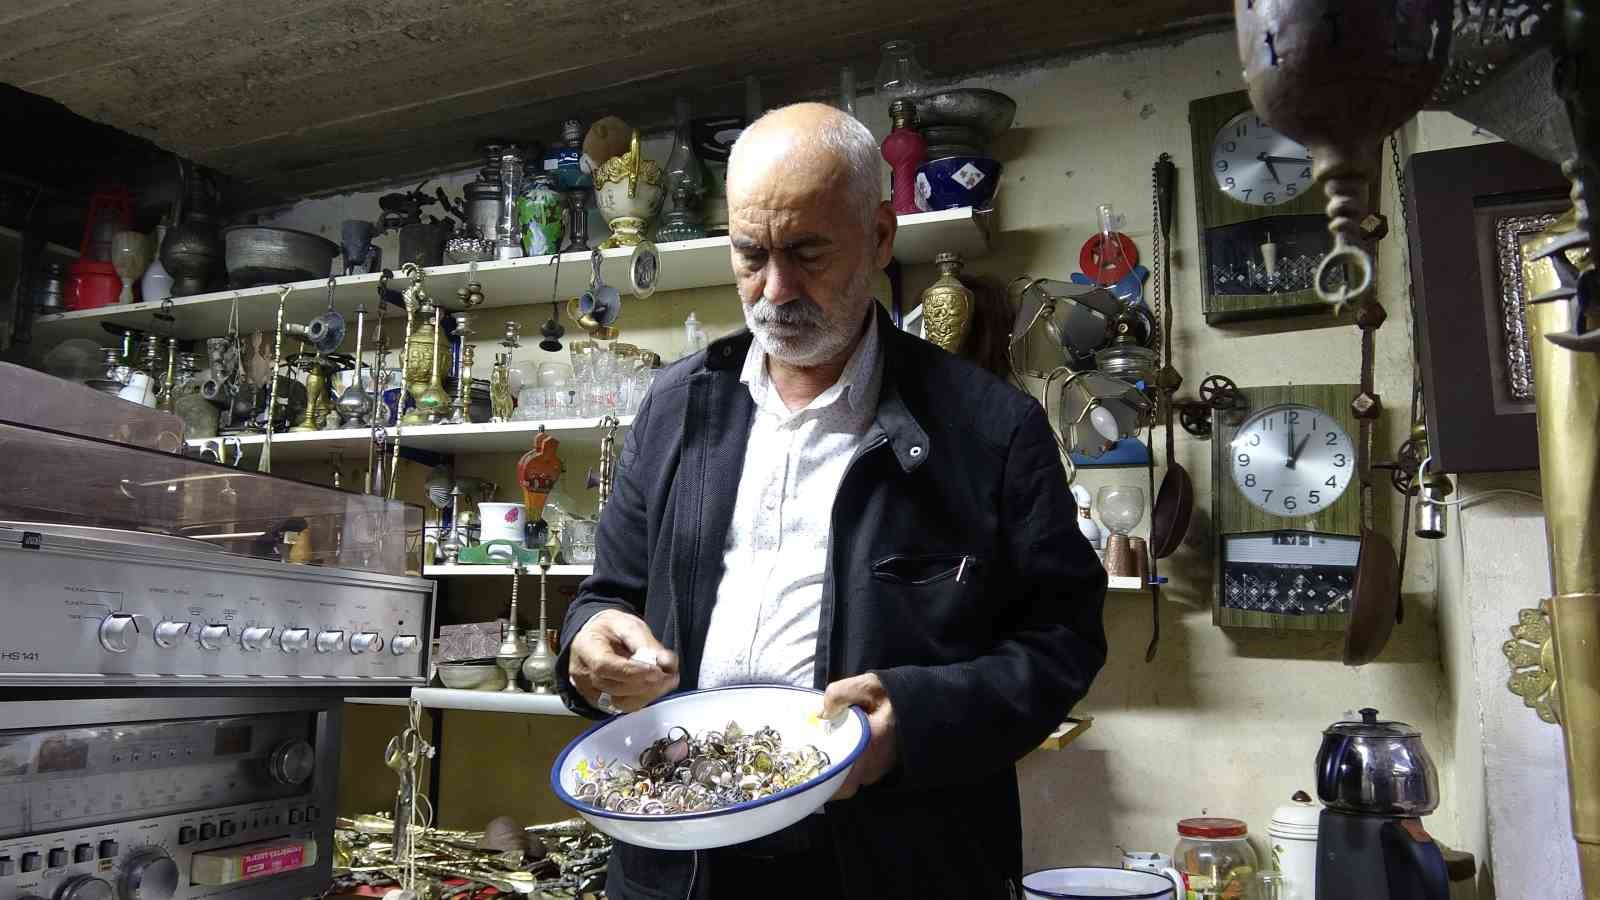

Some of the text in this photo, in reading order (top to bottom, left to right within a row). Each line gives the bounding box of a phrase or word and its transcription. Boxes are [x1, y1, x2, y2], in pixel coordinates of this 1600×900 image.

[1236, 124, 1247, 137] 11
[1215, 160, 1228, 172] 9
[1300, 167, 1312, 178] 4
[1241, 189, 1253, 201] 7
[1287, 183, 1297, 196] 5
[1264, 192, 1276, 204] 6
[1263, 417, 1273, 431] 11
[1283, 411, 1299, 425] 12
[1312, 417, 1317, 431] 1
[1325, 432, 1337, 446] 2
[1238, 453, 1250, 467] 9
[1333, 453, 1346, 467] 3
[1244, 473, 1257, 488] 8
[1324, 474, 1337, 489] 4
[1262, 489, 1274, 503] 7
[1283, 495, 1297, 510] 6
[1308, 490, 1321, 504] 5
[22, 651, 39, 661] 141
